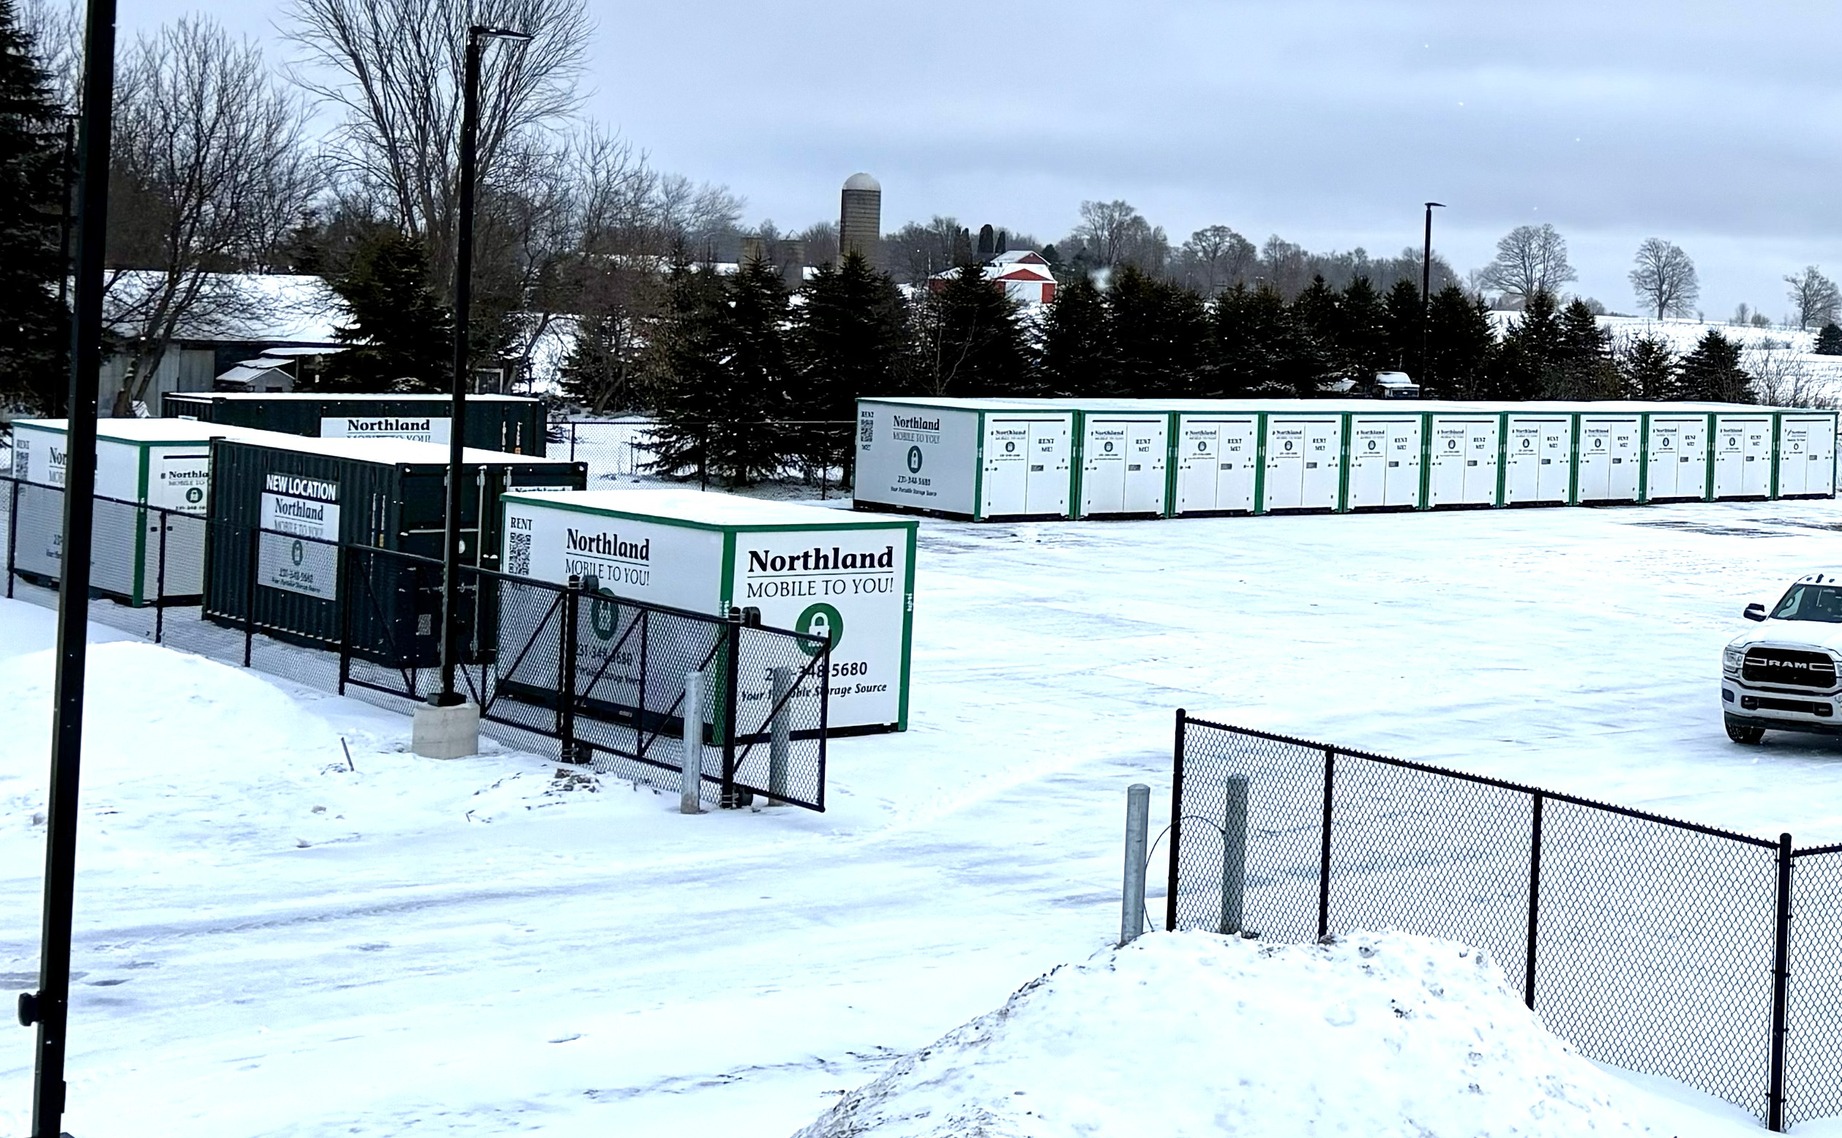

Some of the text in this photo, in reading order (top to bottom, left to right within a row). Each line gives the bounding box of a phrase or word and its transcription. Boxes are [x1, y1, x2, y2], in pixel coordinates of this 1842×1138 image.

[348, 419, 430, 431] Northland
[893, 415, 940, 431] Northland
[266, 474, 336, 501] NEW LOCATION
[275, 497, 324, 521] Northland
[510, 517, 532, 531] RENT
[566, 528, 650, 561] Northland
[748, 546, 893, 573] Northland
[565, 558, 650, 586] MOBILE TO YOU!
[747, 577, 893, 598] MOBILE TO YOU!
[1768, 660, 1807, 669] RAM
[854, 682, 888, 694] Source
